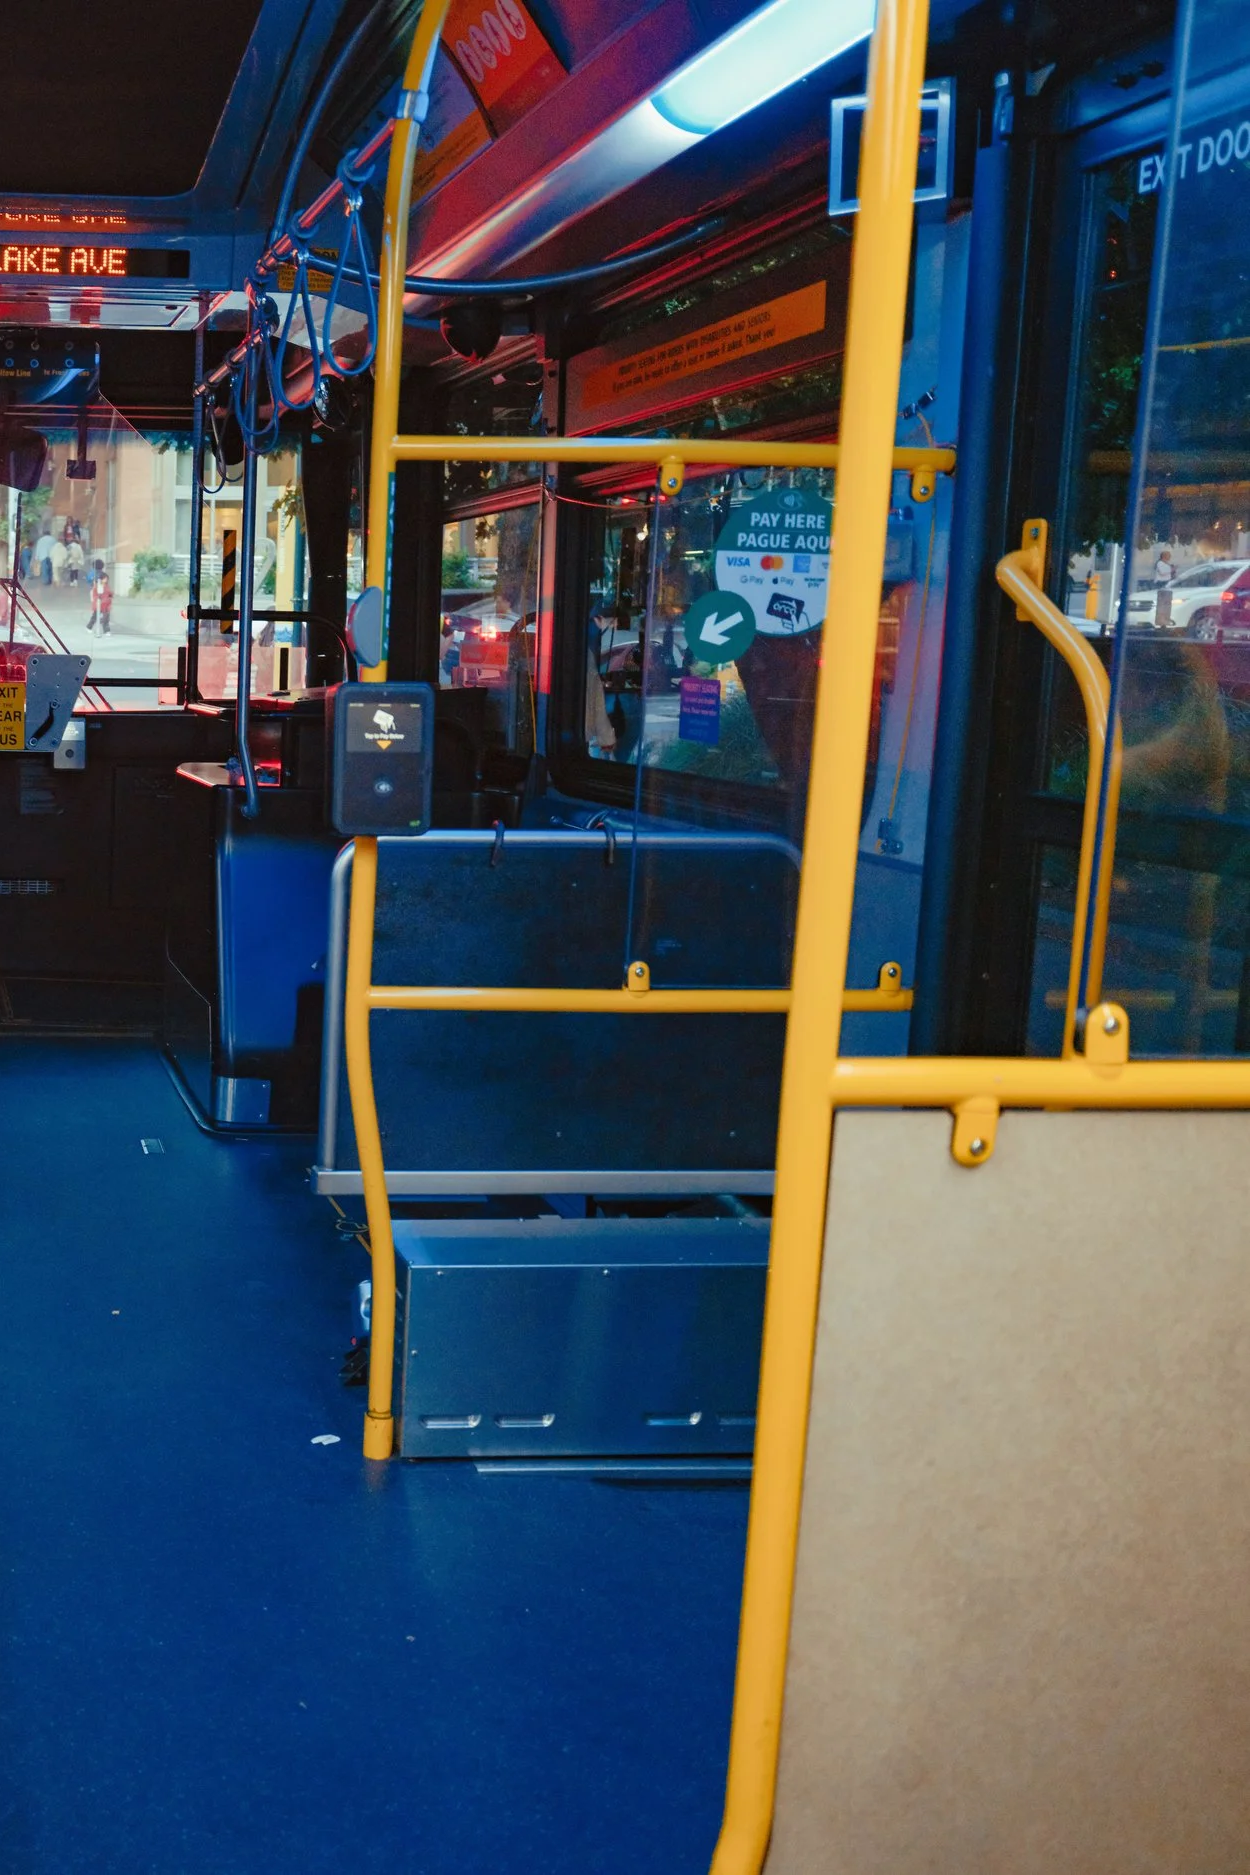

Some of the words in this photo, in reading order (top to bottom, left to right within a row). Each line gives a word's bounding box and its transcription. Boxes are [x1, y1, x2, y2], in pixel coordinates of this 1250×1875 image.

[1138, 144, 1192, 194] EXT
[70, 247, 127, 275] AVE
[750, 512, 780, 528] PAY
[784, 513, 826, 529] HERE
[737, 532, 791, 549] PAGUE
[726, 556, 751, 567] VISA
